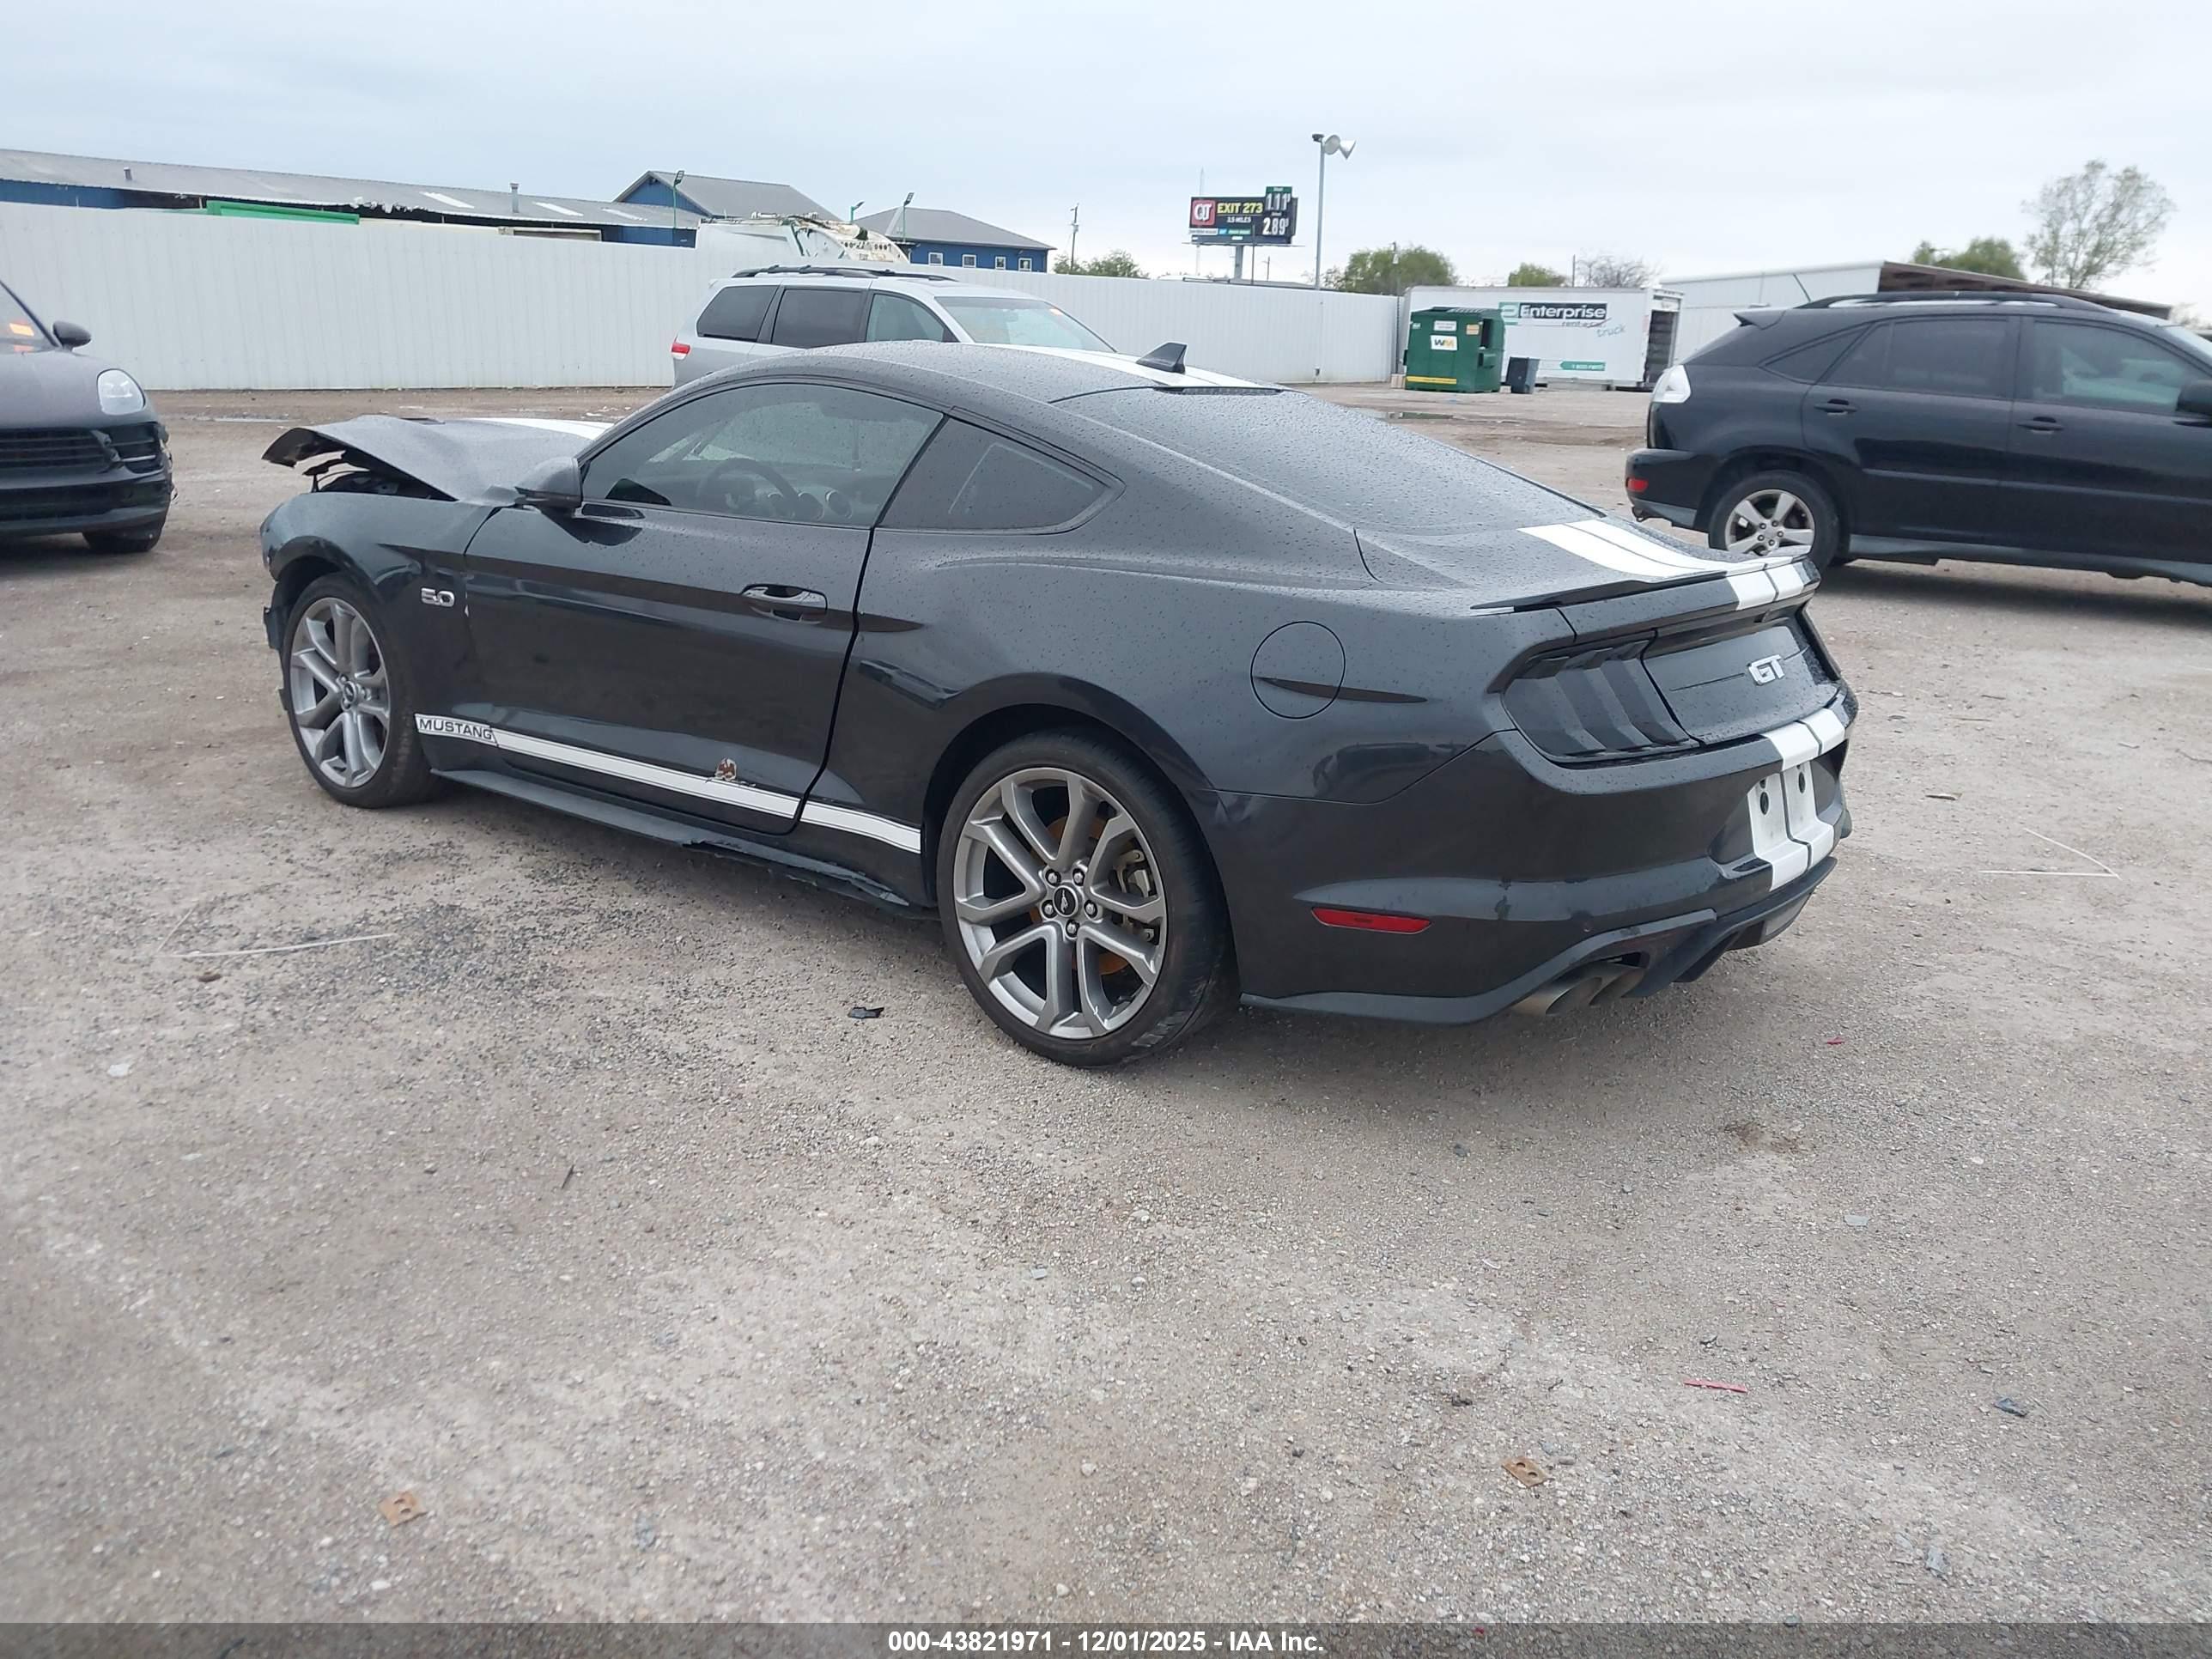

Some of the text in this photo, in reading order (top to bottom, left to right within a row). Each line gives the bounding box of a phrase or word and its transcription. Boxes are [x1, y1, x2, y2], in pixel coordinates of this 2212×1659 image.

[1217, 203, 1263, 214] EXIT 273
[1520, 304, 1606, 320] Enterprise
[421, 587, 455, 607] 5.0
[1748, 654, 1786, 686] GT
[419, 718, 494, 740] MUSTANG
